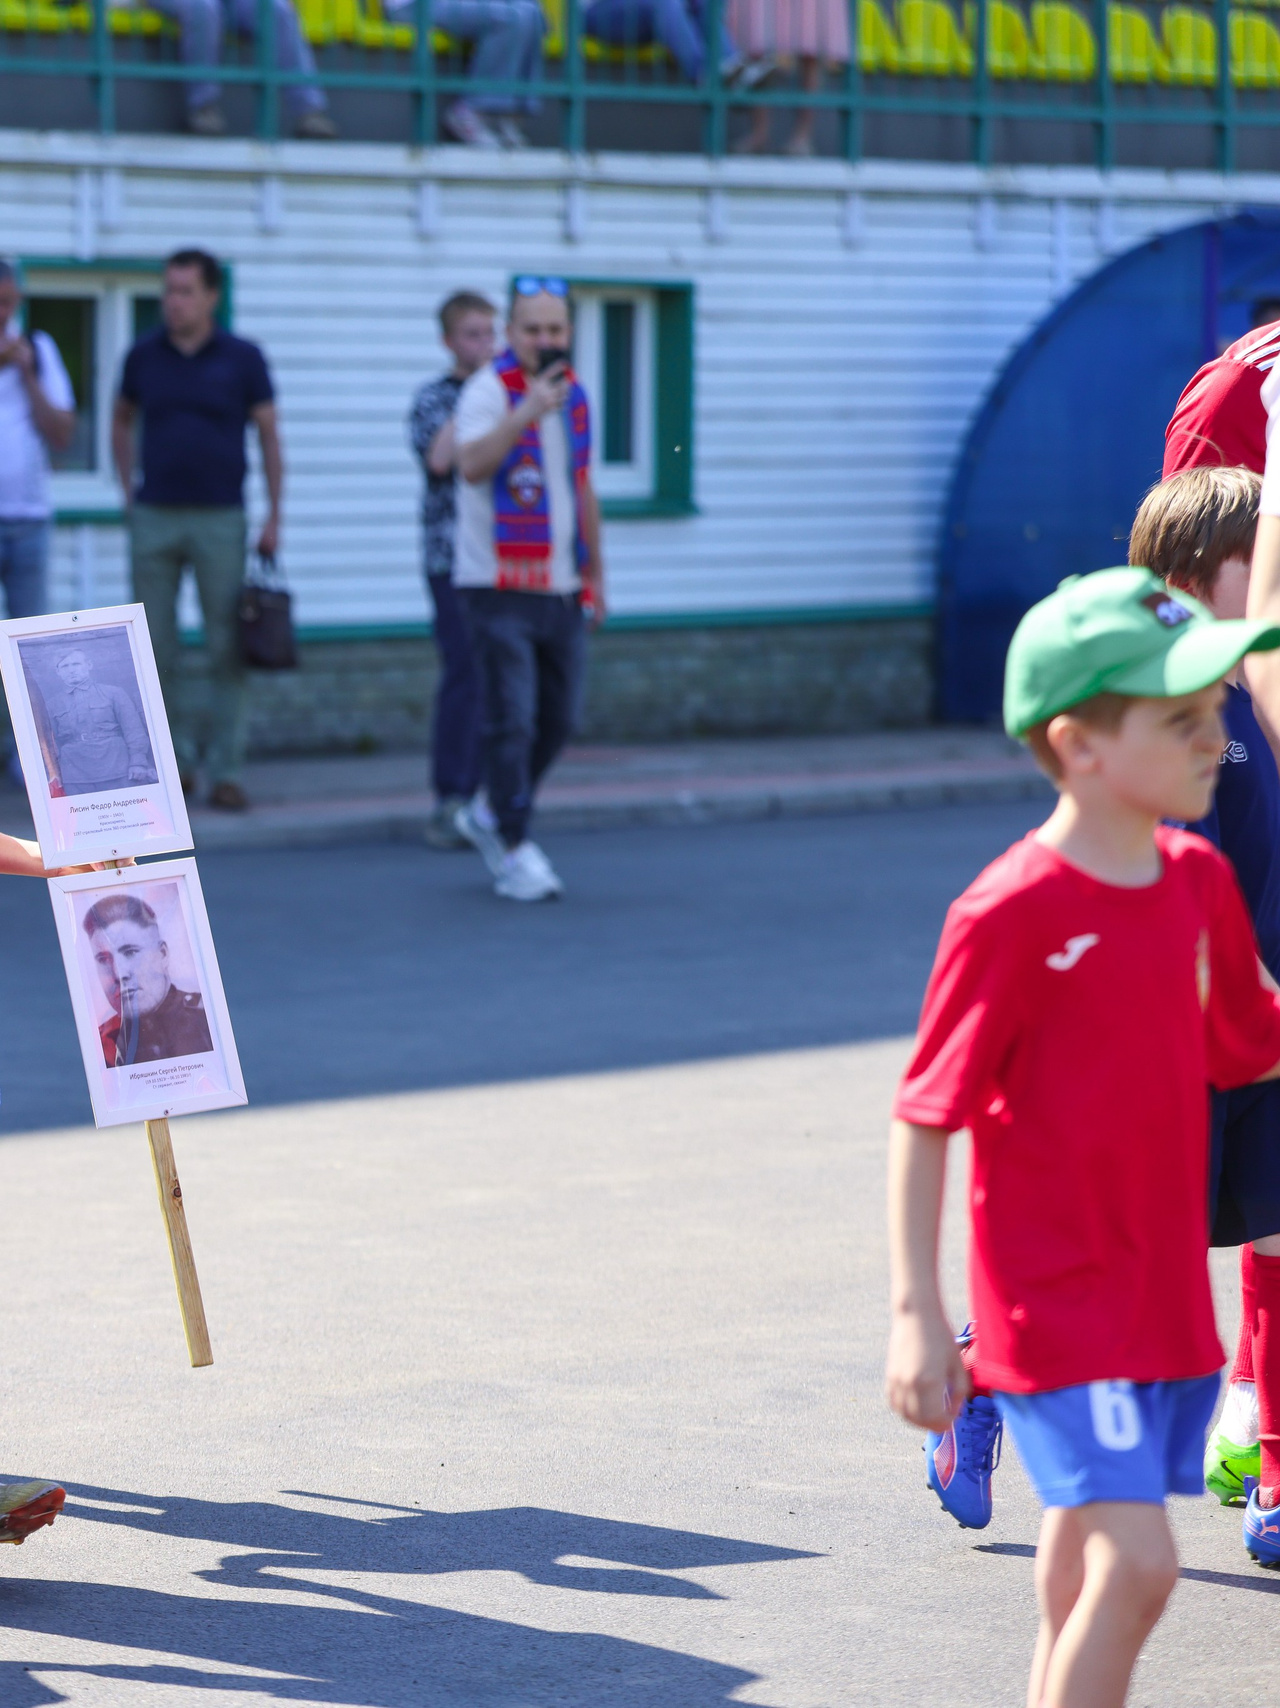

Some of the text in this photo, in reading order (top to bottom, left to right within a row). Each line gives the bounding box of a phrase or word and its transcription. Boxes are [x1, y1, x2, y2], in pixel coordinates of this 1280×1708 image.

[158, 1067, 177, 1075] Сергей
[178, 1063, 204, 1071] Петрович
[1088, 1377, 1143, 1452] 6
